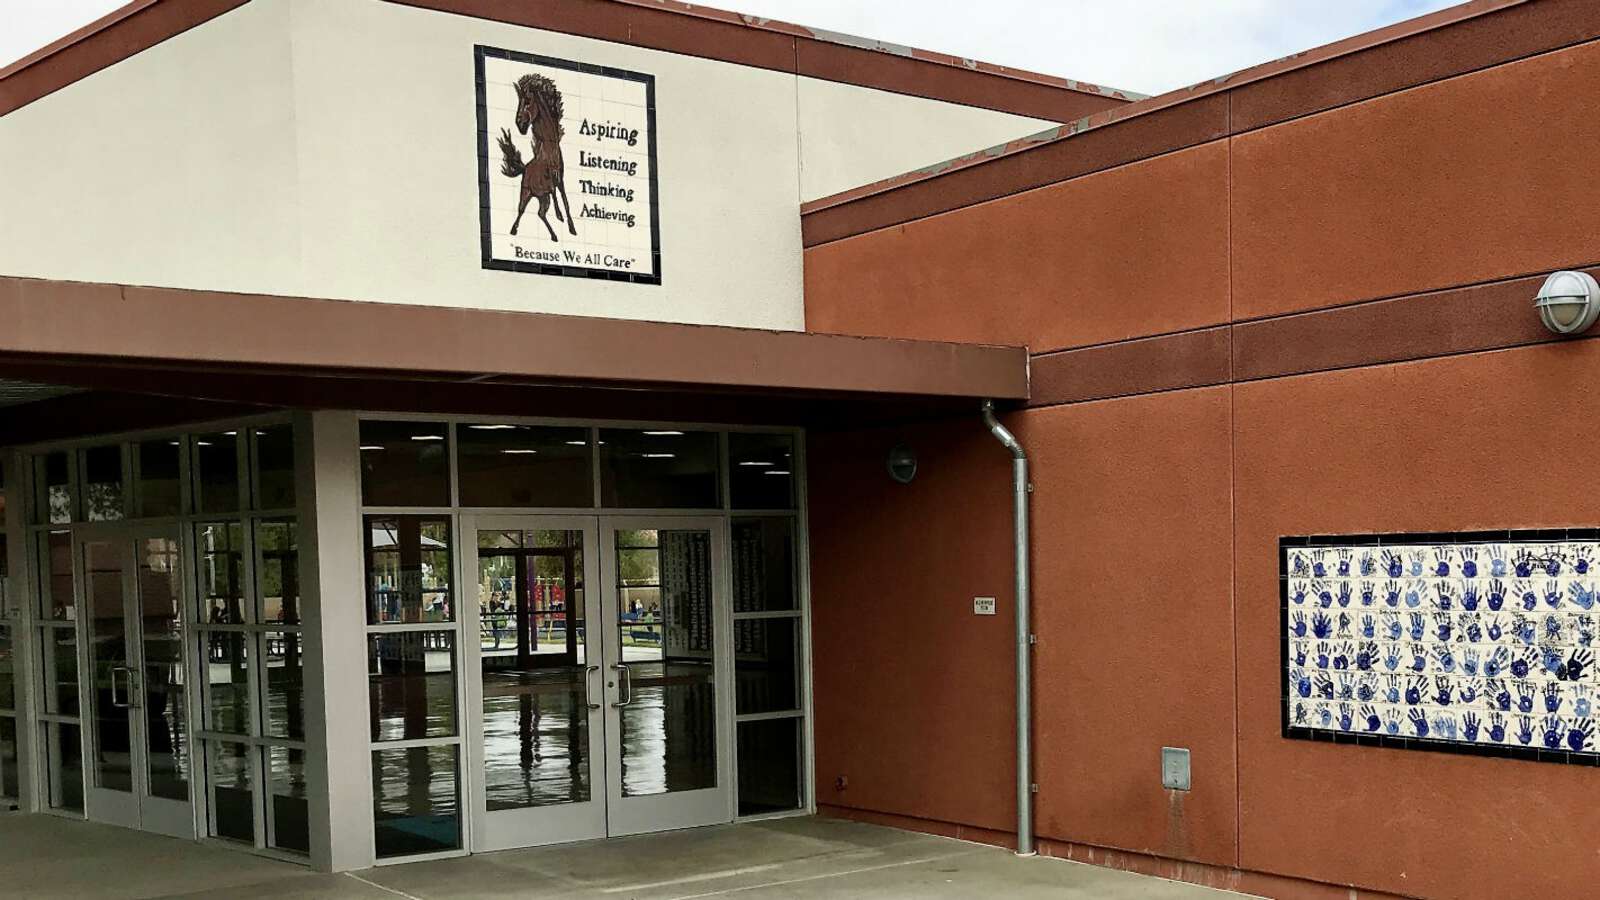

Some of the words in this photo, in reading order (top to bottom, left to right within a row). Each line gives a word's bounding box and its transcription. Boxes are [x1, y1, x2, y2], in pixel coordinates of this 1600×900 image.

[579, 118, 638, 146] Aspiring
[579, 150, 637, 176] Listening
[579, 179, 634, 202] Thinking
[580, 203, 635, 227] Achieving
[563, 250, 581, 263] We
[584, 253, 601, 265] All
